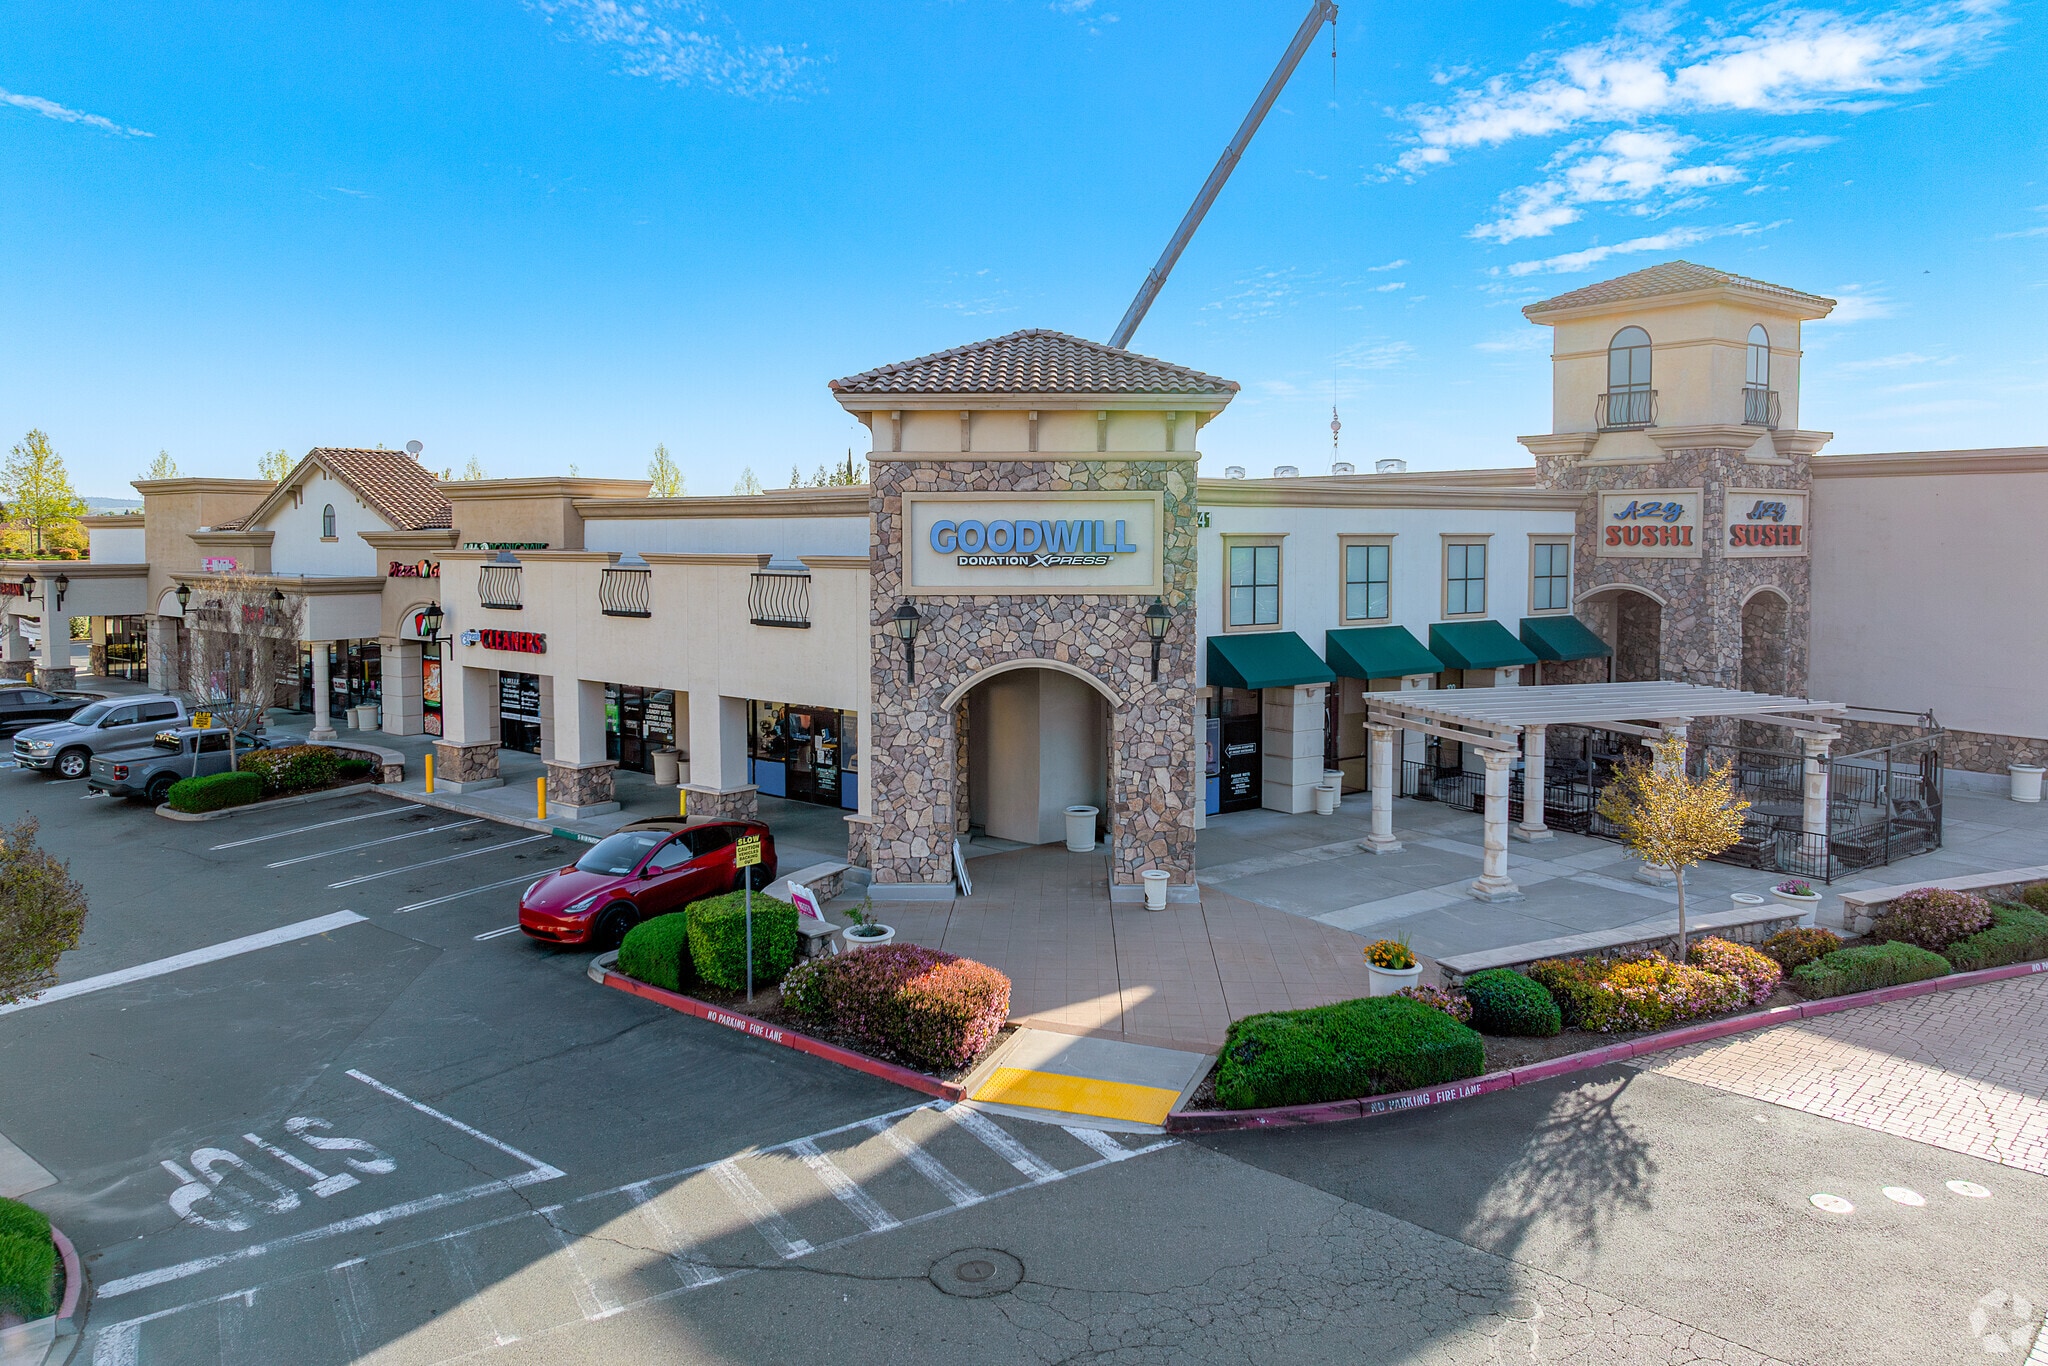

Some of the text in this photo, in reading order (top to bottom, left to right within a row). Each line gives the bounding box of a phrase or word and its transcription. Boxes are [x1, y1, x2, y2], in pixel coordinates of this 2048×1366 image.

[930, 520, 1137, 554] GOODWILL
[1605, 525, 1693, 546] SUSHI
[1732, 524, 1802, 546] SUSHI
[388, 561, 417, 577] Pizza
[958, 555, 1029, 567] DONATION
[481, 629, 544, 654] CLEANERS
[737, 834, 760, 846] SLOW
[737, 843, 760, 853] CAUTION
[2031, 963, 2041, 973] NO
[707, 1010, 783, 1043] NO PARKING FIRE LANE
[1370, 1083, 1482, 1113] NO PARKING FIRE LANE
[159, 1115, 399, 1234] STOP
